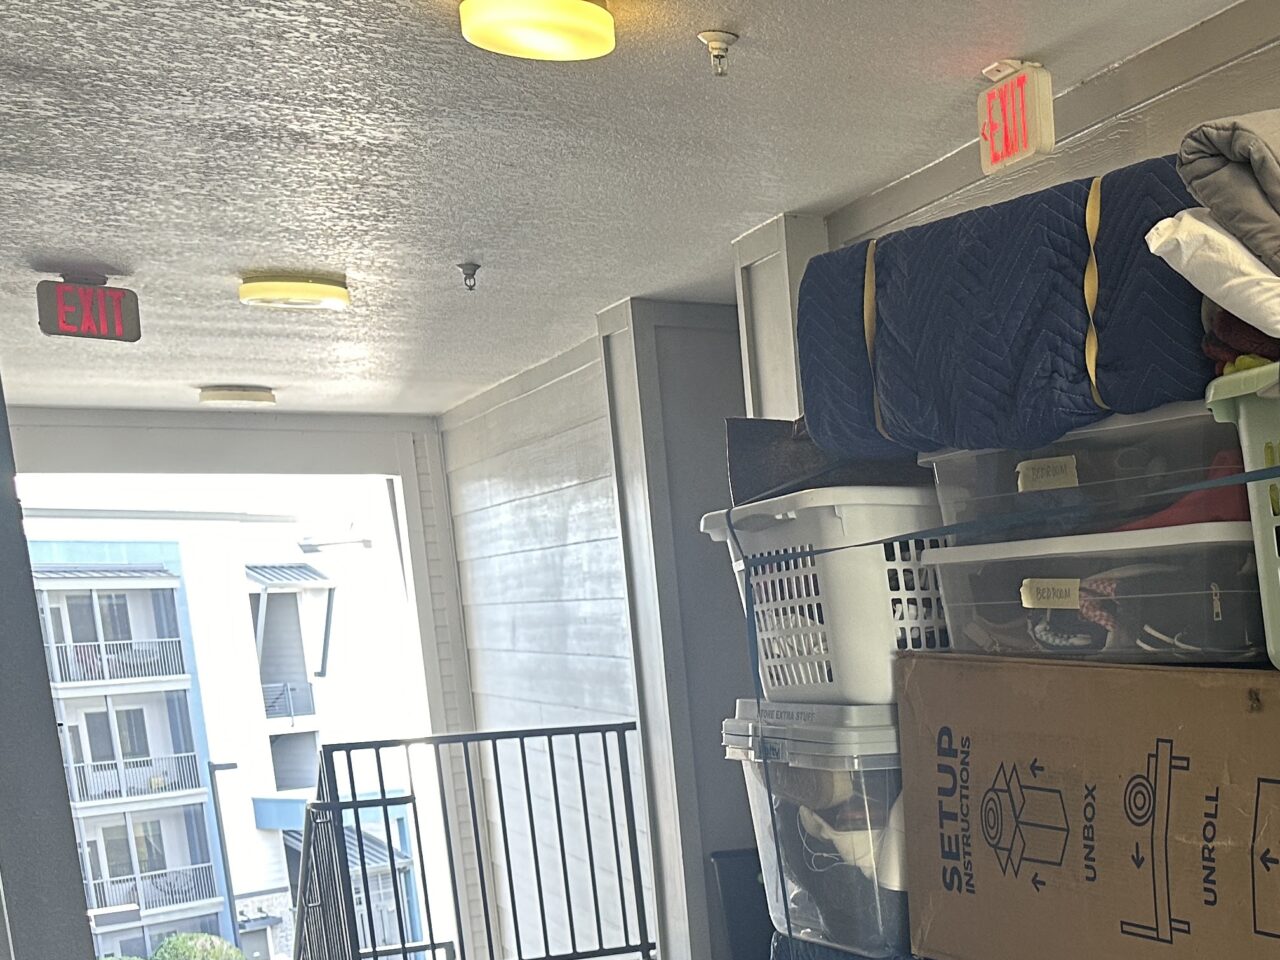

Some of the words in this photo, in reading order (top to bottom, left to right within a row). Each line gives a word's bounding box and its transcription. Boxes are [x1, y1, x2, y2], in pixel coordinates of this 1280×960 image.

[987, 73, 1029, 163] EXIT
[56, 283, 126, 337] EXIT
[1032, 462, 1067, 481] BEDROOM
[1036, 587, 1070, 601] BEDROOM
[937, 726, 962, 894] SETUP
[960, 735, 976, 895] INSTRUCTIONS
[1083, 784, 1097, 882] UNBOX
[1202, 786, 1220, 907] UNROLL
